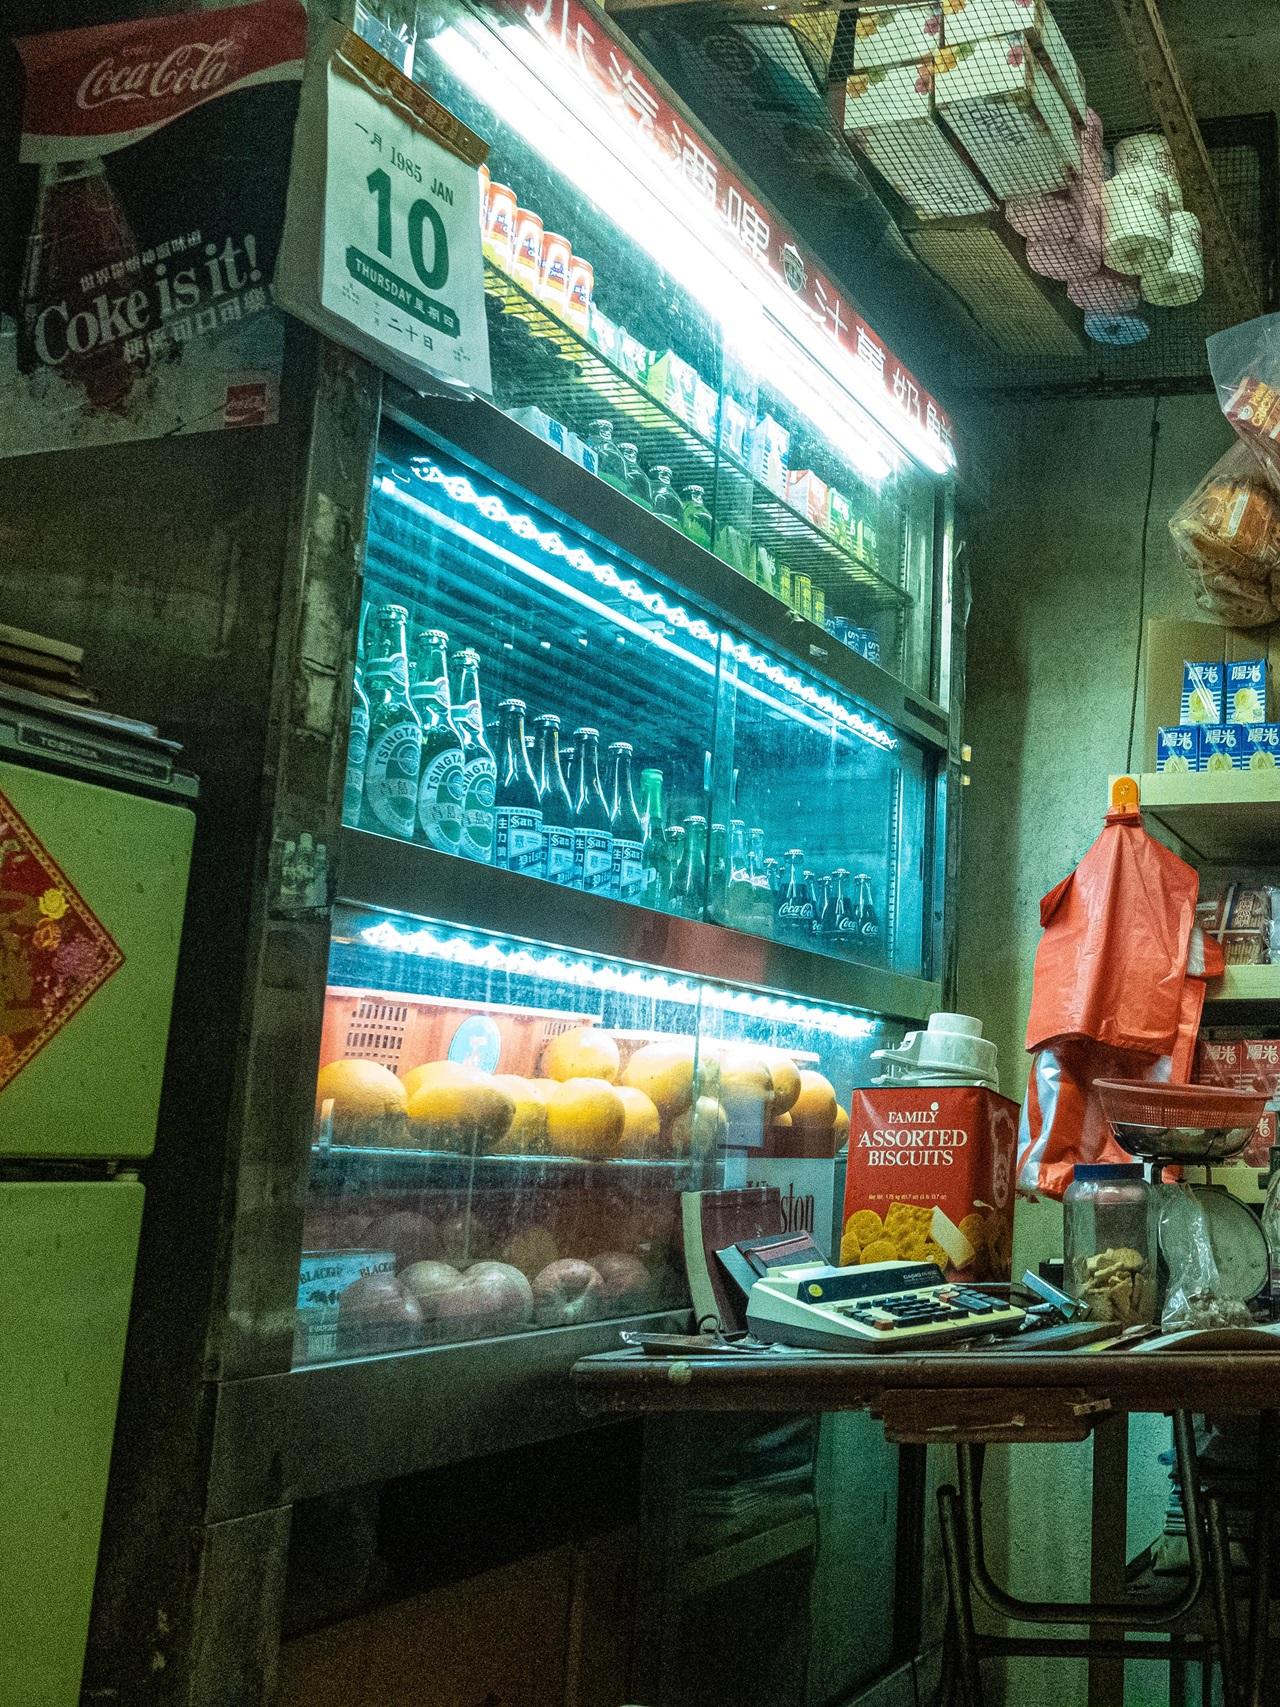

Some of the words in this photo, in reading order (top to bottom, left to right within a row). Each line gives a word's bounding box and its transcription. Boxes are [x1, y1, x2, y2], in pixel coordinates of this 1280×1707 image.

[76, 38, 234, 110] Coca-Cola
[355, 122, 382, 152] 一月
[391, 146, 422, 180] 1985
[430, 178, 454, 207] JAN
[366, 168, 450, 290] 10
[355, 258, 412, 304] THURSDAY
[34, 284, 150, 365] Coke
[156, 263, 201, 319] is
[202, 234, 262, 298] it!
[414, 297, 454, 328] 星期四
[387, 318, 434, 351] 二十日
[1231, 664, 1262, 682] 陽光
[1162, 732, 1193, 750] 陽光
[1205, 729, 1237, 748] 陽光
[1248, 727, 1280, 746] 陽光
[427, 753, 465, 791] TSINGTA
[510, 815, 533, 829] San
[551, 834, 570, 847] San
[586, 836, 607, 849] San
[1246, 1044, 1279, 1064] 陽光
[887, 1111, 939, 1124] FAMILY
[857, 1129, 968, 1148] ASSORTED
[867, 1149, 954, 1166] BISCUITS
